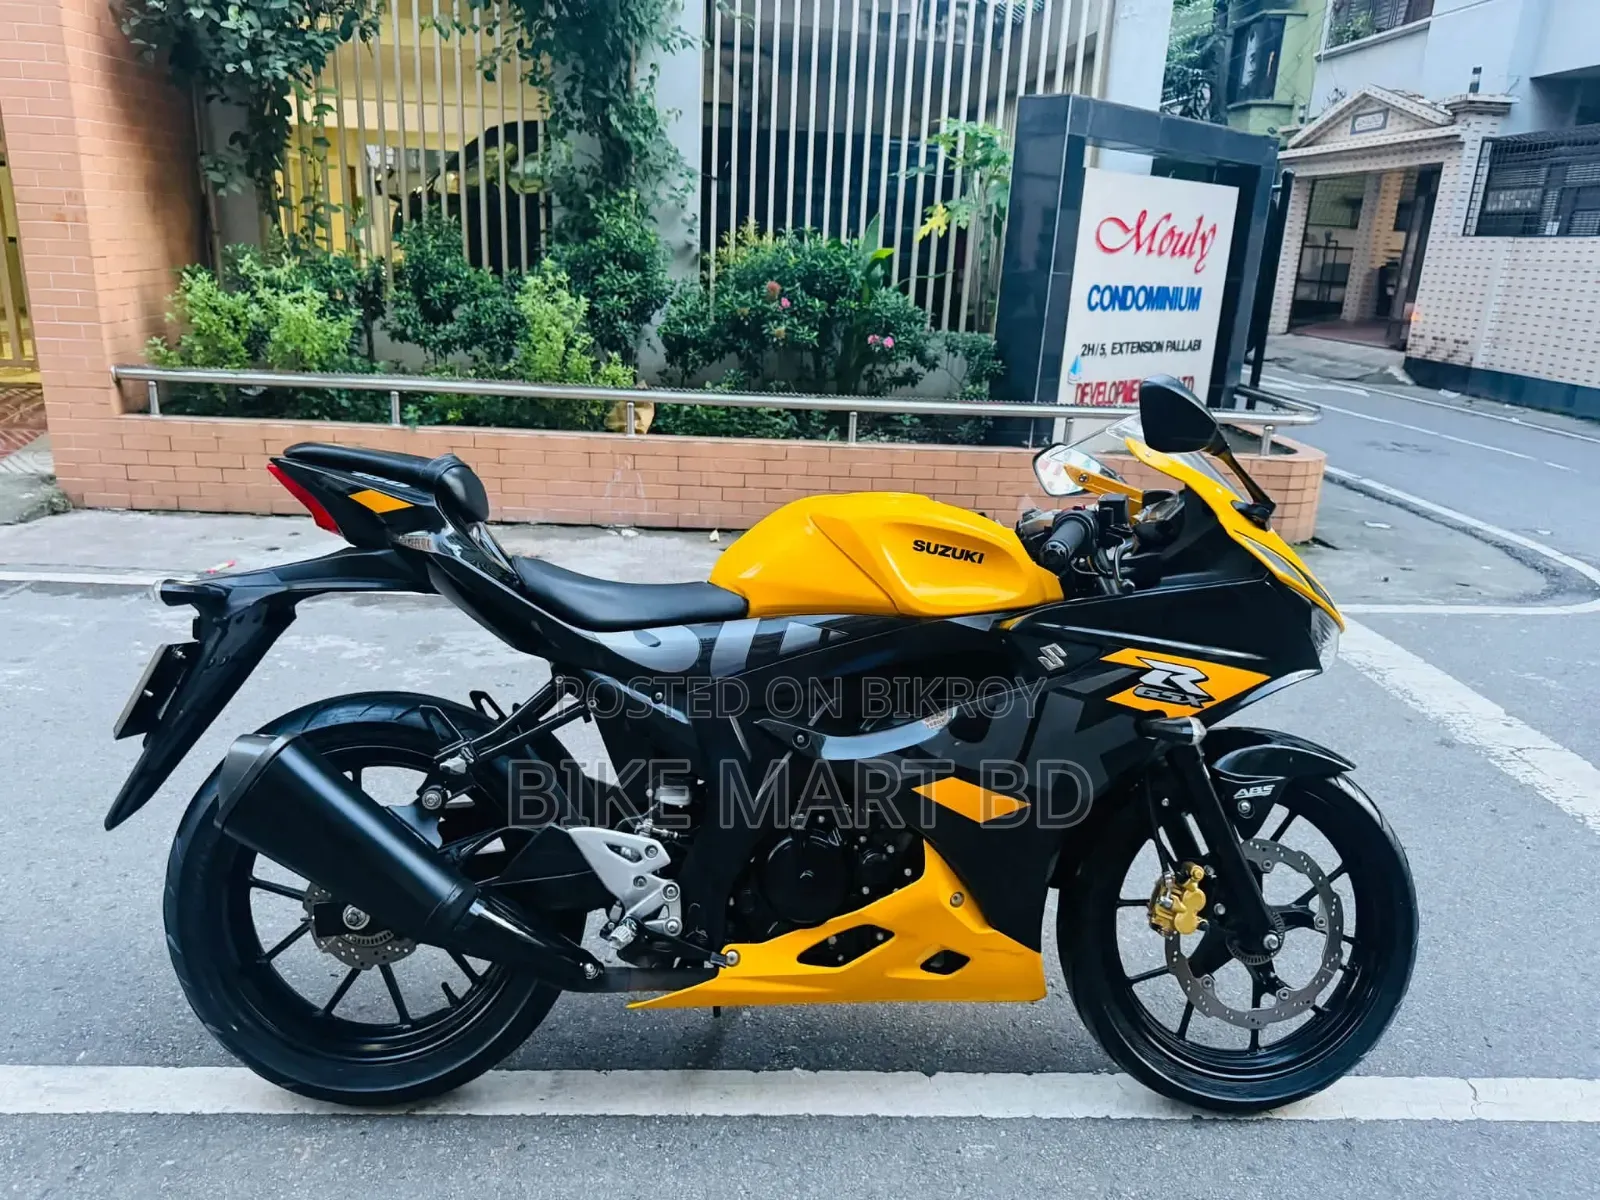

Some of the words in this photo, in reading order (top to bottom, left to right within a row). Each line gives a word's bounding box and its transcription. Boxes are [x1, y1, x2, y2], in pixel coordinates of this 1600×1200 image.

[1095, 209, 1217, 274] Mouly
[1087, 284, 1202, 312] CONDOMINIUM
[1081, 343, 1107, 358] 2H/5,
[1111, 340, 1164, 355] EXTENSION
[912, 539, 985, 565] SUZUKI
[1133, 684, 1209, 708] GSX
[1233, 785, 1275, 799] ABS
